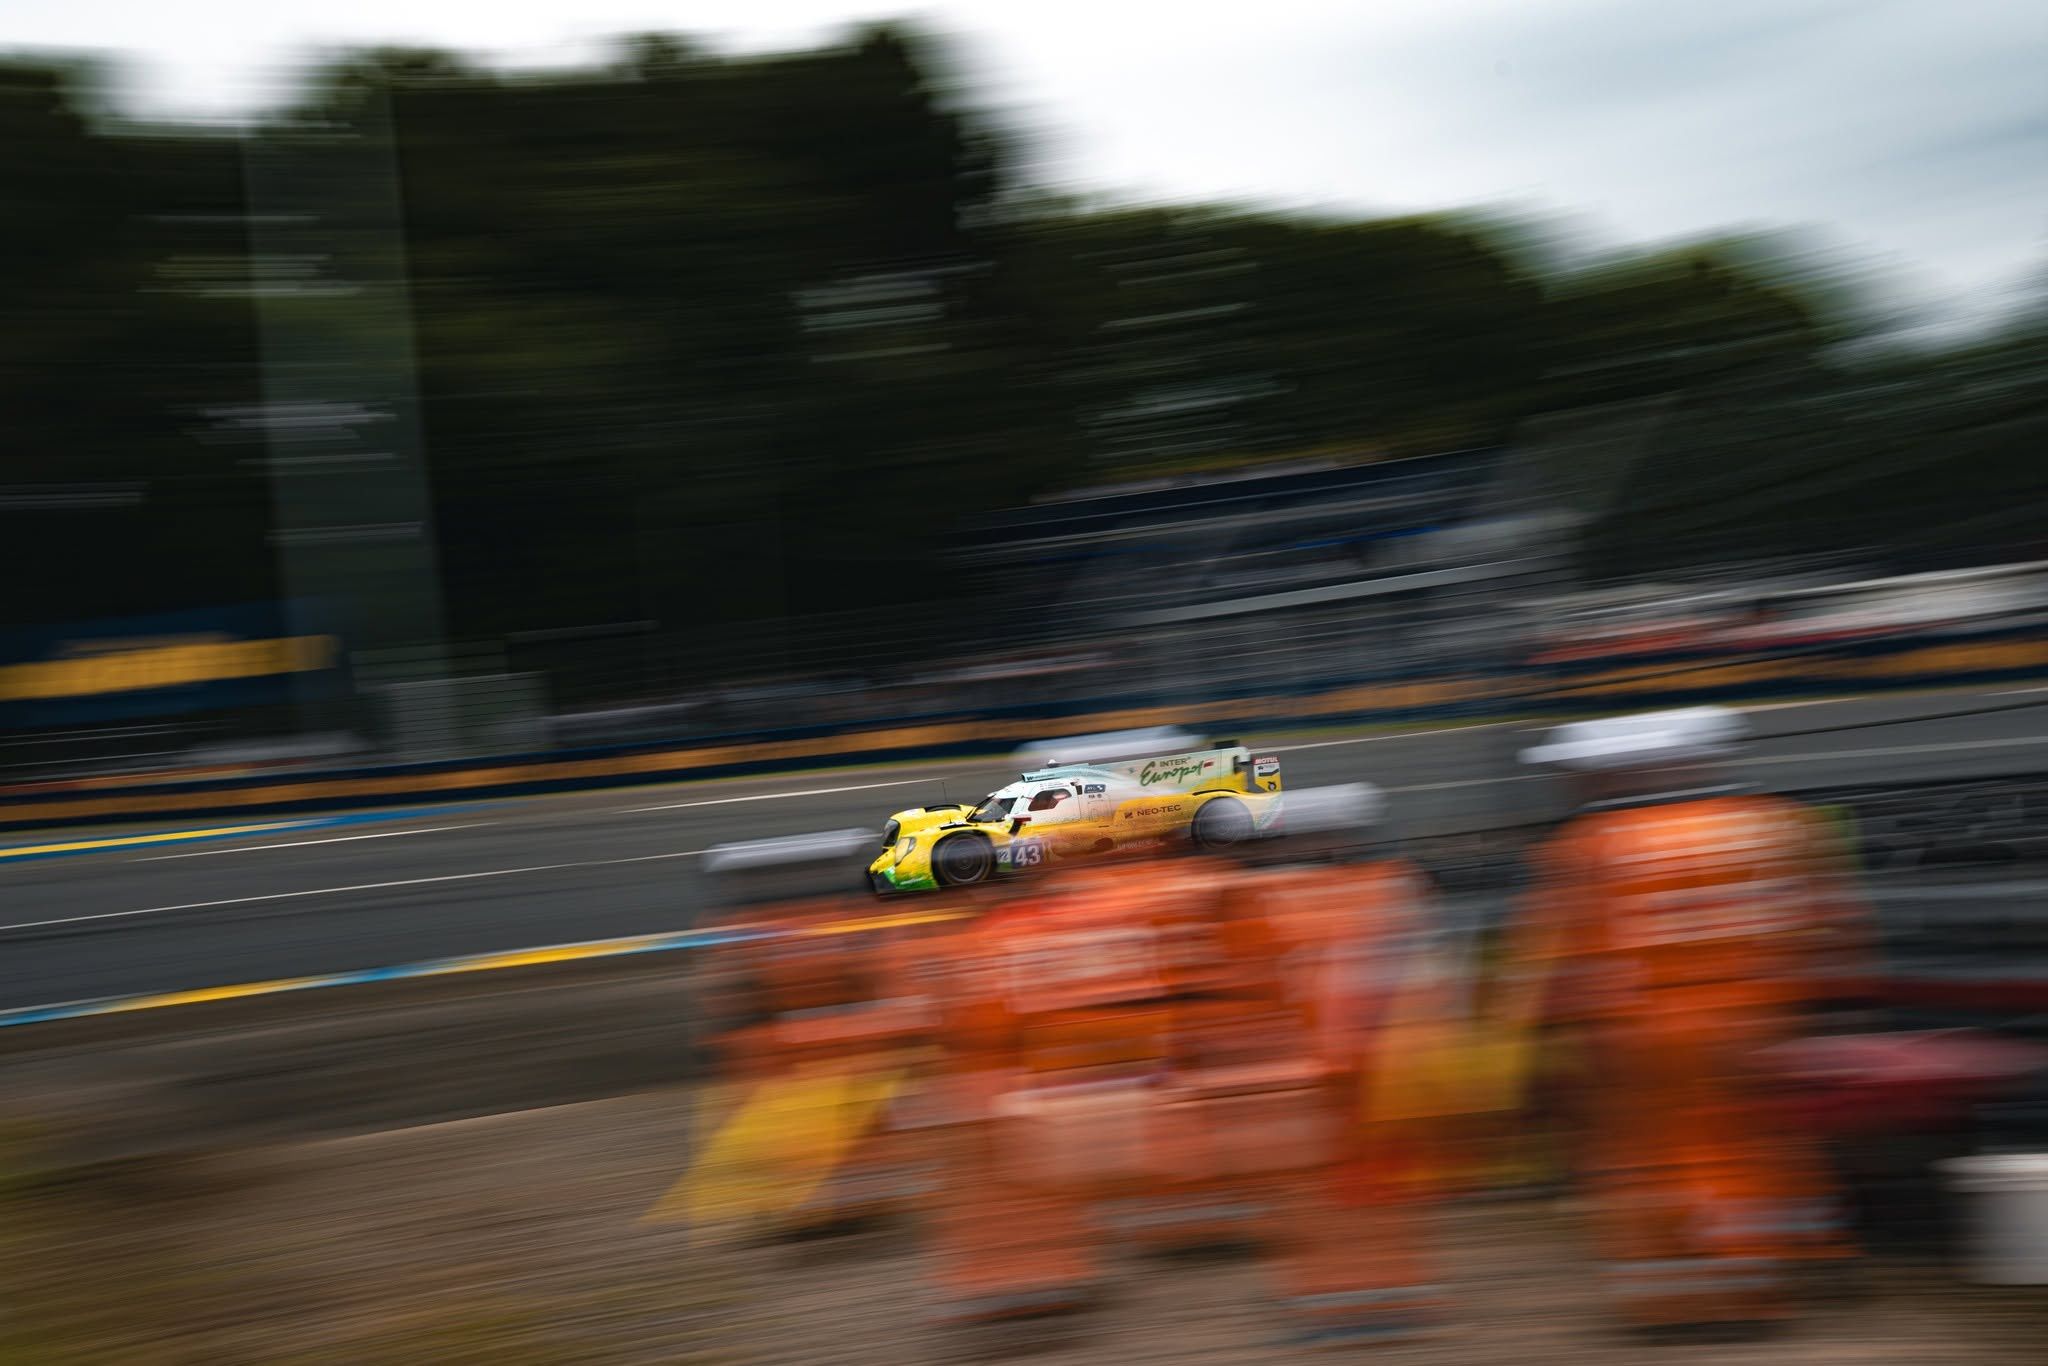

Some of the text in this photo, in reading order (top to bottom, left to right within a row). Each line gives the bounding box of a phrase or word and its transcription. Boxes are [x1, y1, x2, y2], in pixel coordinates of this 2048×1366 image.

[1160, 758, 1188, 768] INTER
[1140, 760, 1204, 787] Europol
[1137, 804, 1182, 817] NEO-TEC
[1015, 844, 1041, 867] 43
